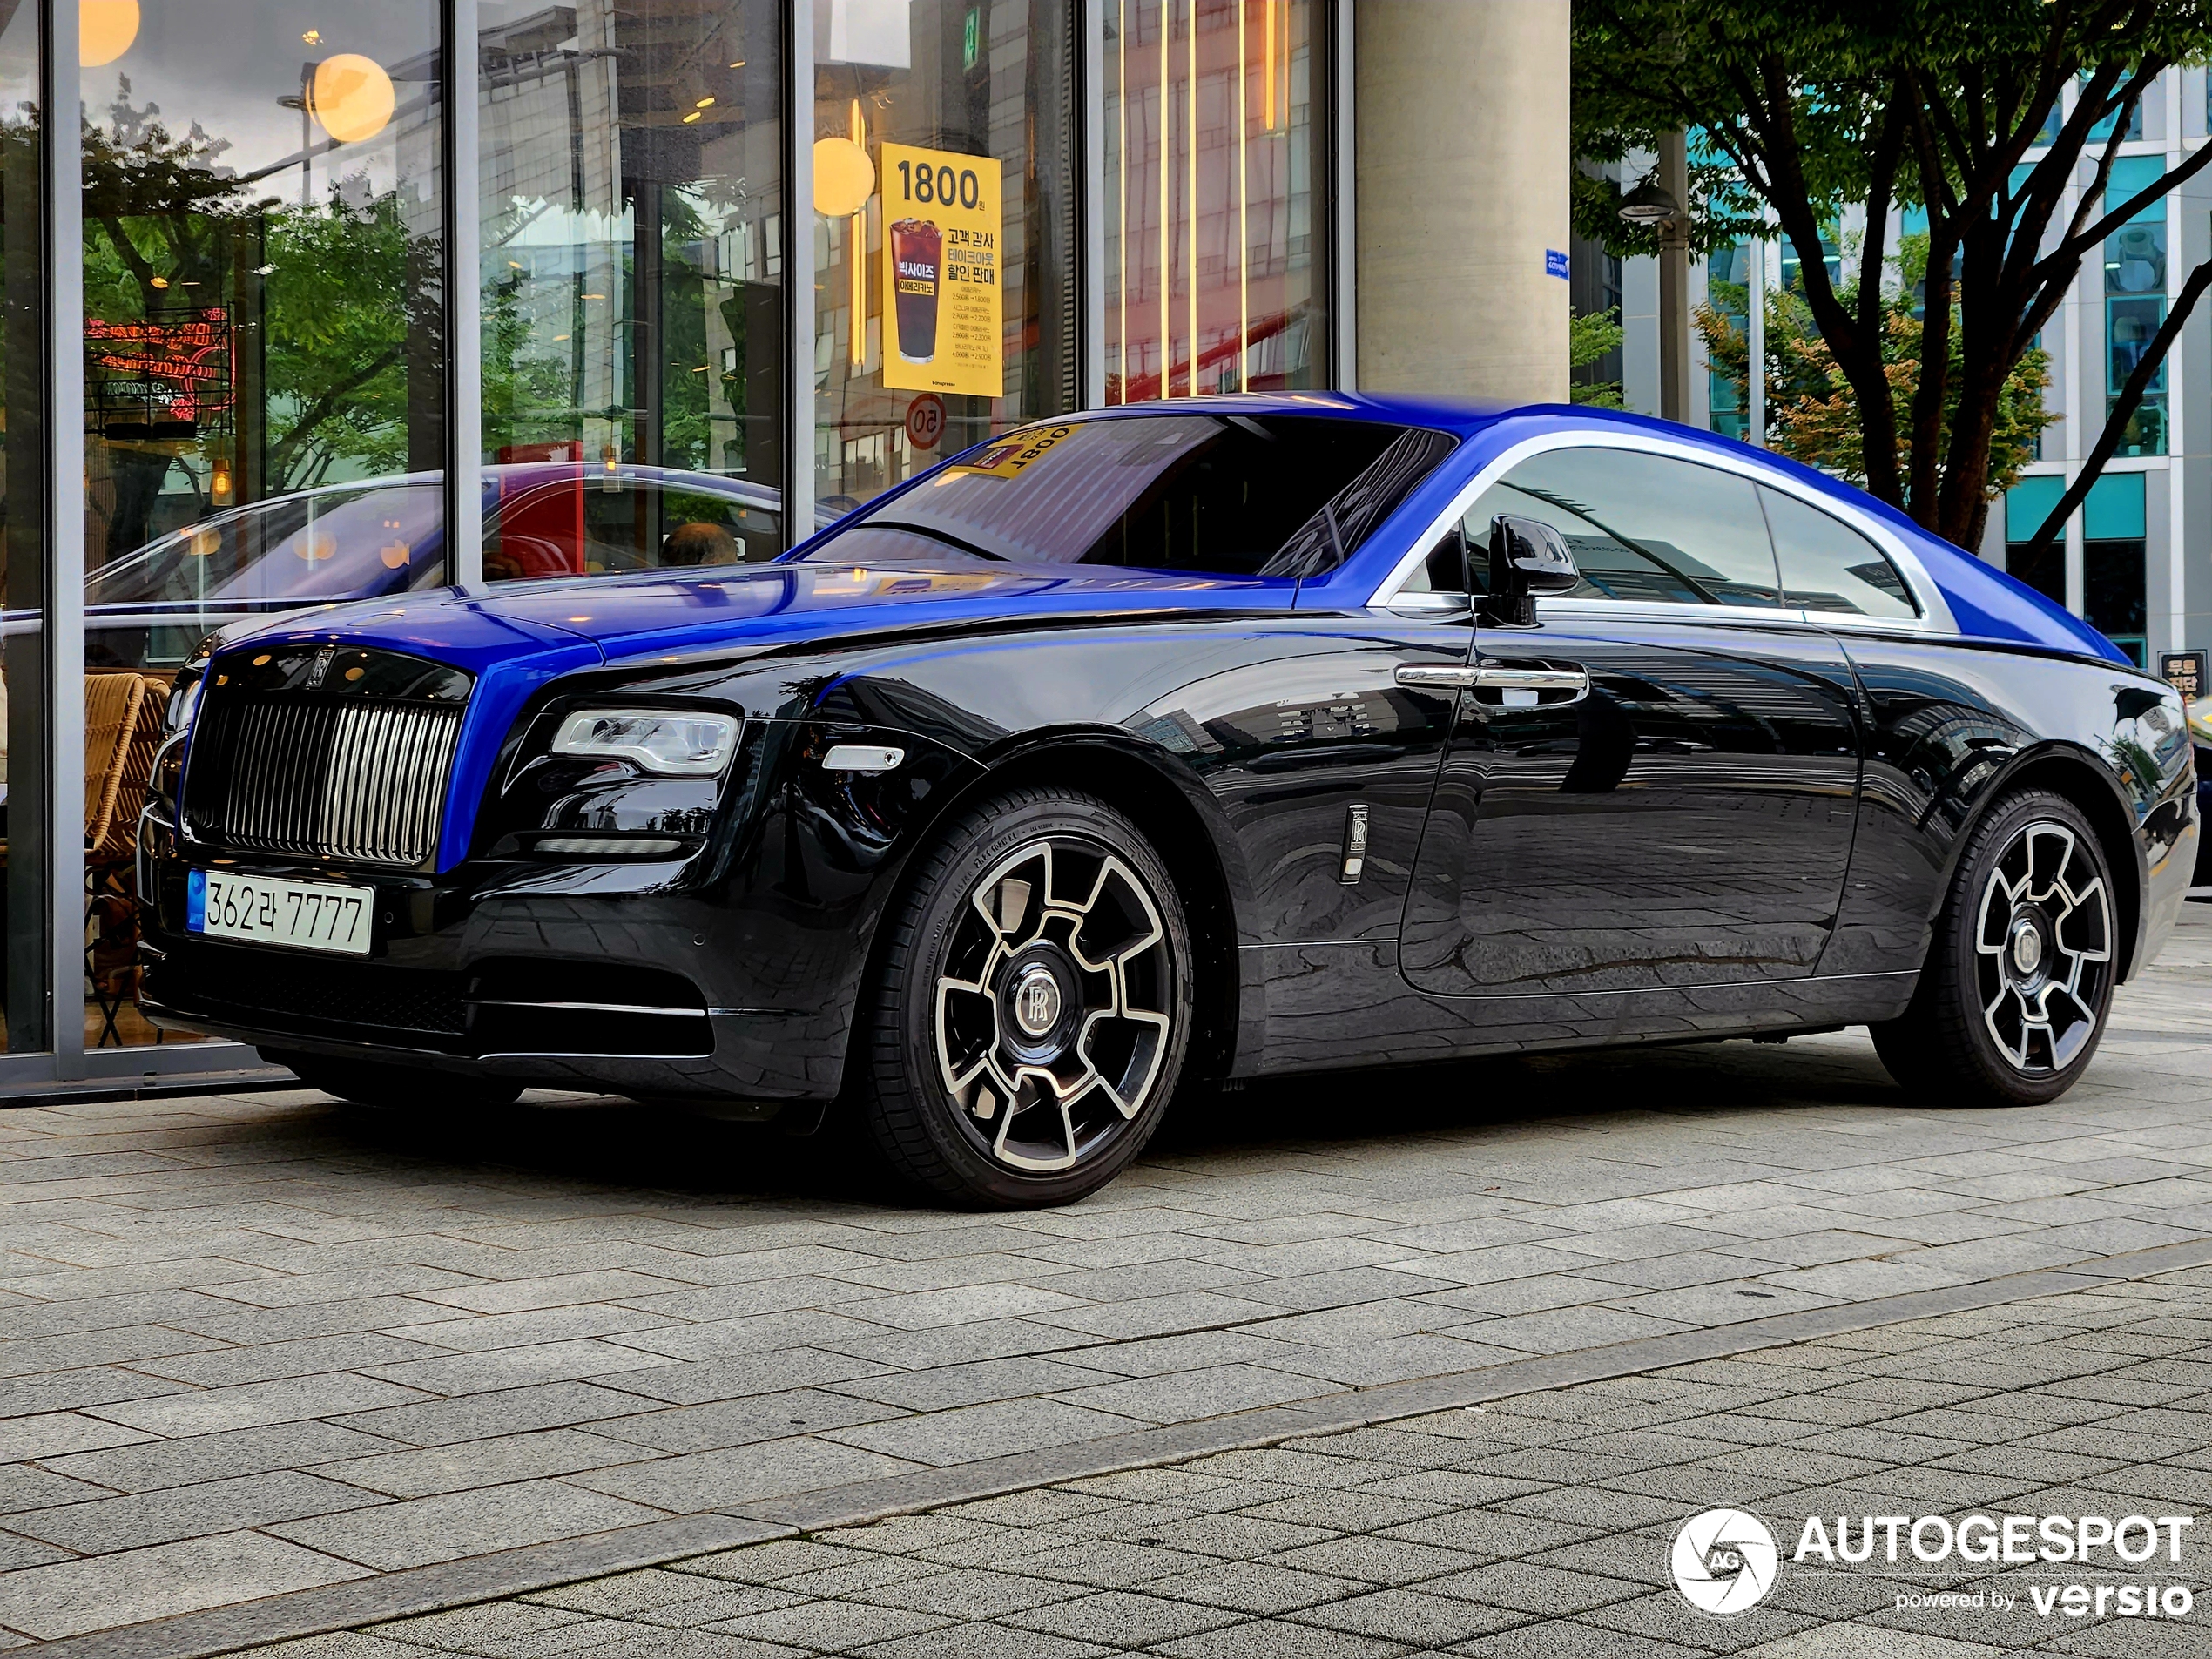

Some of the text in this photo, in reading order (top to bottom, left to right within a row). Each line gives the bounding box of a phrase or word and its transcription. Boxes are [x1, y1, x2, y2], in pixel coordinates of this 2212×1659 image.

[898, 160, 979, 209] 1800
[948, 228, 994, 249] 고객 감사
[948, 248, 994, 266] 테이크아웃
[899, 261, 934, 278] 빅사이즈
[948, 264, 994, 285] 할인 판매
[900, 280, 933, 293] 아메리카노
[2168, 659, 2197, 675] 무료
[207, 881, 363, 942] 362라 7777
